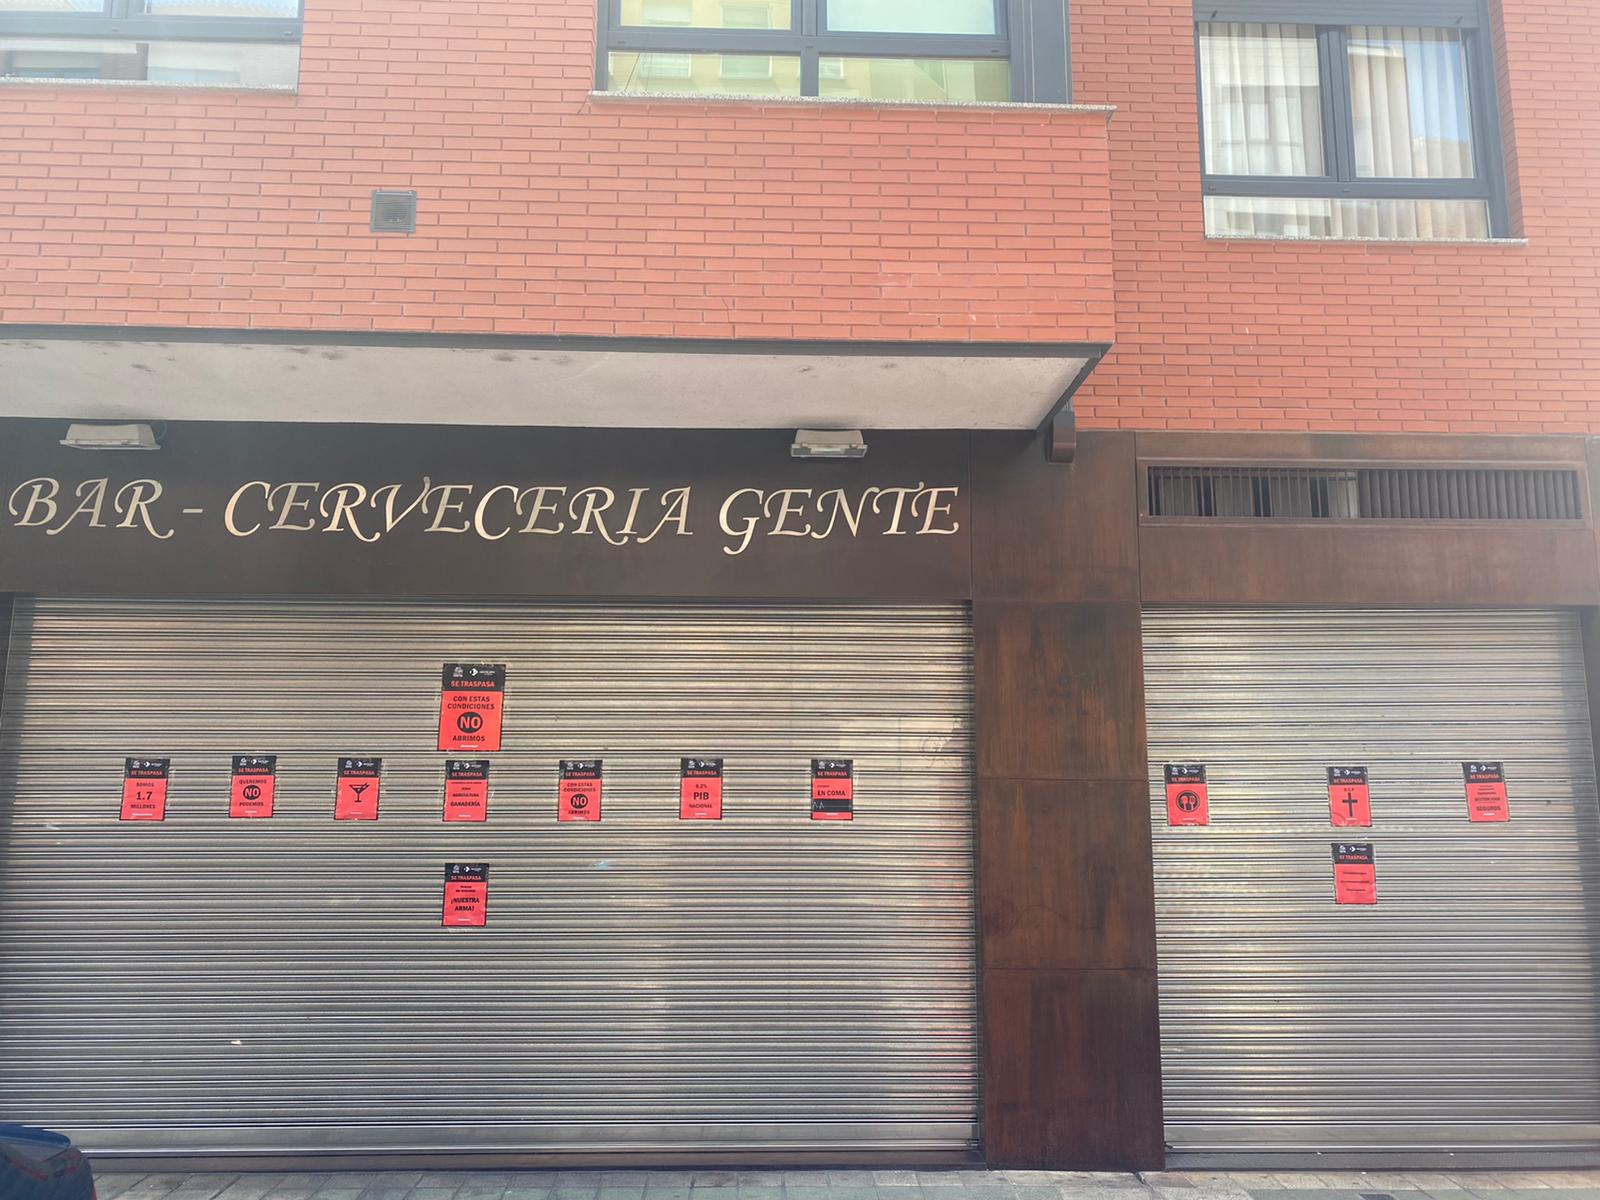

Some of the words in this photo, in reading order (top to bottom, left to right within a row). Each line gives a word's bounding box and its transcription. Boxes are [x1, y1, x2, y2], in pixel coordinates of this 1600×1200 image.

[9, 477, 174, 538] BAR
[224, 476, 693, 546] CERVECERIA
[719, 481, 960, 555] GENTE
[450, 680, 459, 688] SE
[460, 680, 496, 688] TRASPASA
[460, 716, 481, 729] NO
[136, 791, 153, 800] 1.7
[244, 787, 259, 797] NO
[693, 791, 709, 800] PIB
[572, 796, 587, 806] NO
[451, 897, 480, 905] ¡NUESTRA
